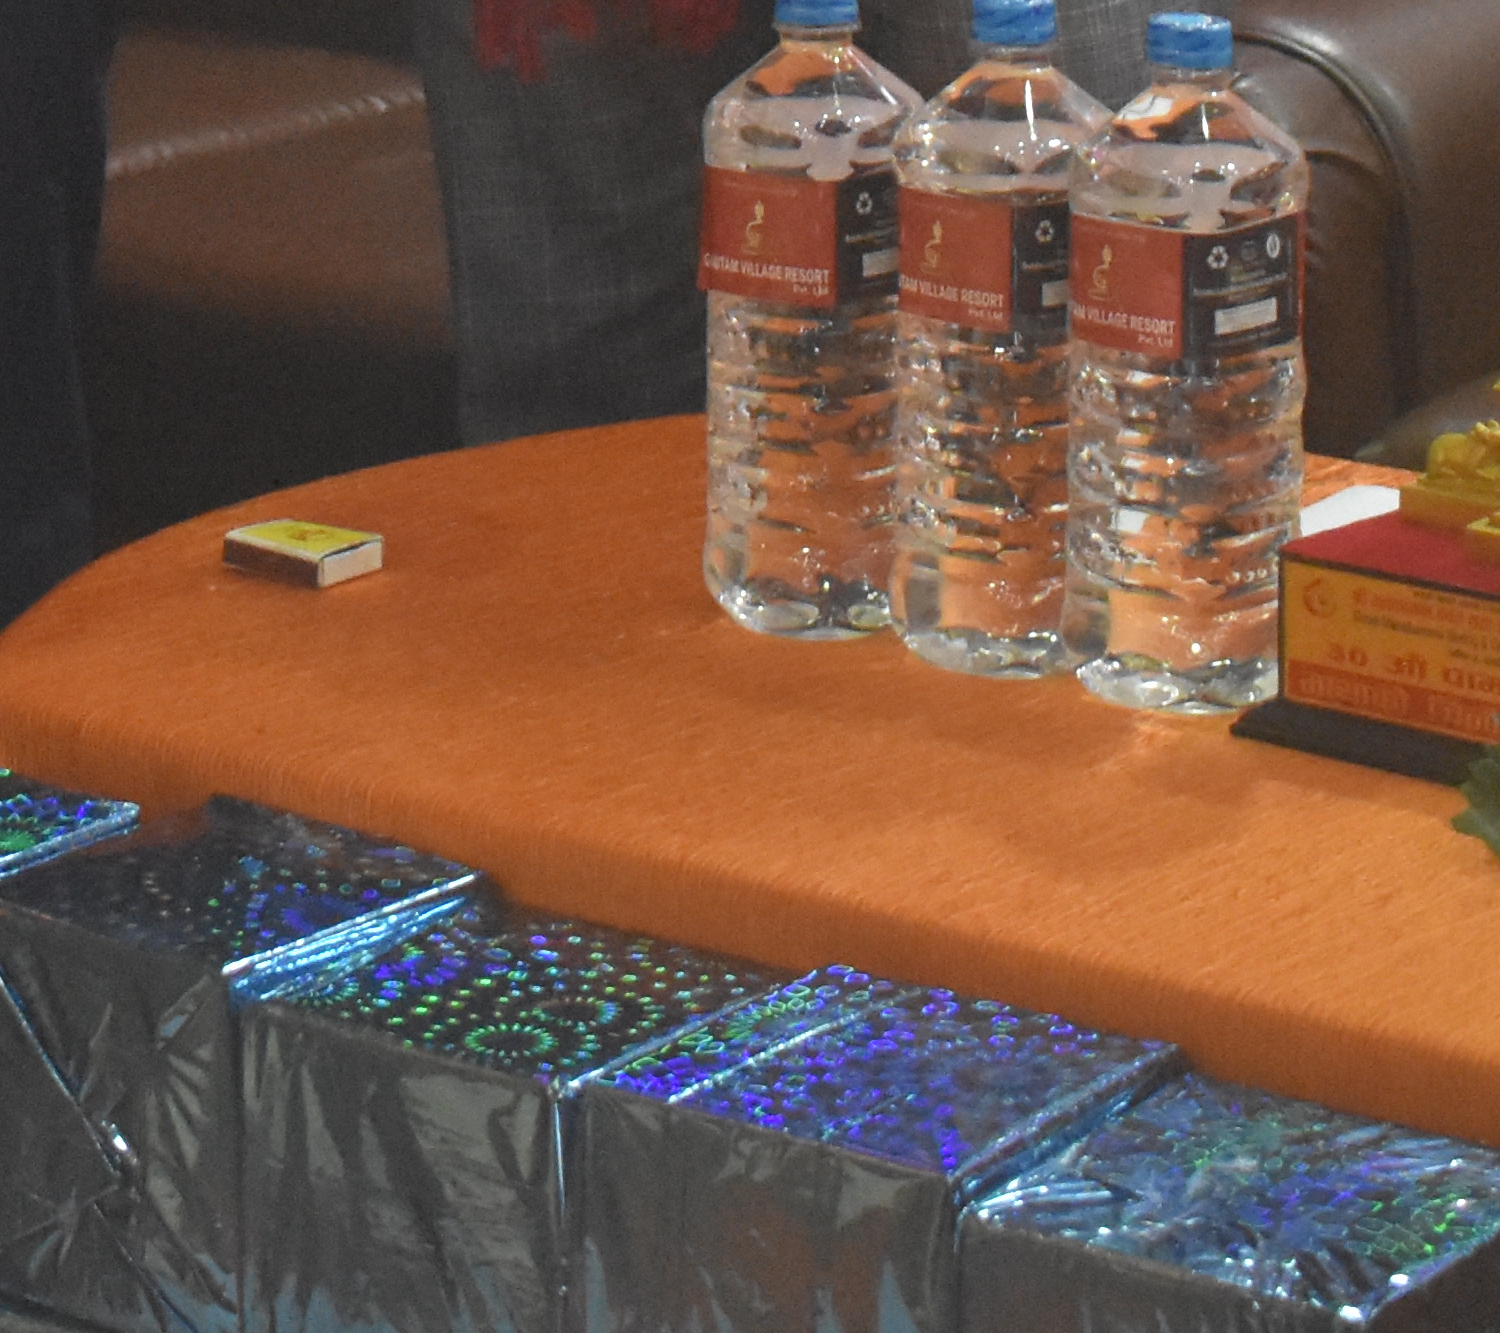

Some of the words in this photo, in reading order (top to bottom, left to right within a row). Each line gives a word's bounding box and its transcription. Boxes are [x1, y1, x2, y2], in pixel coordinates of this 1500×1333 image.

[740, 261, 783, 282] VILLAGE
[785, 265, 830, 285] RESORT
[961, 288, 1004, 308] RESORT
[1130, 315, 1176, 335] RESORT
